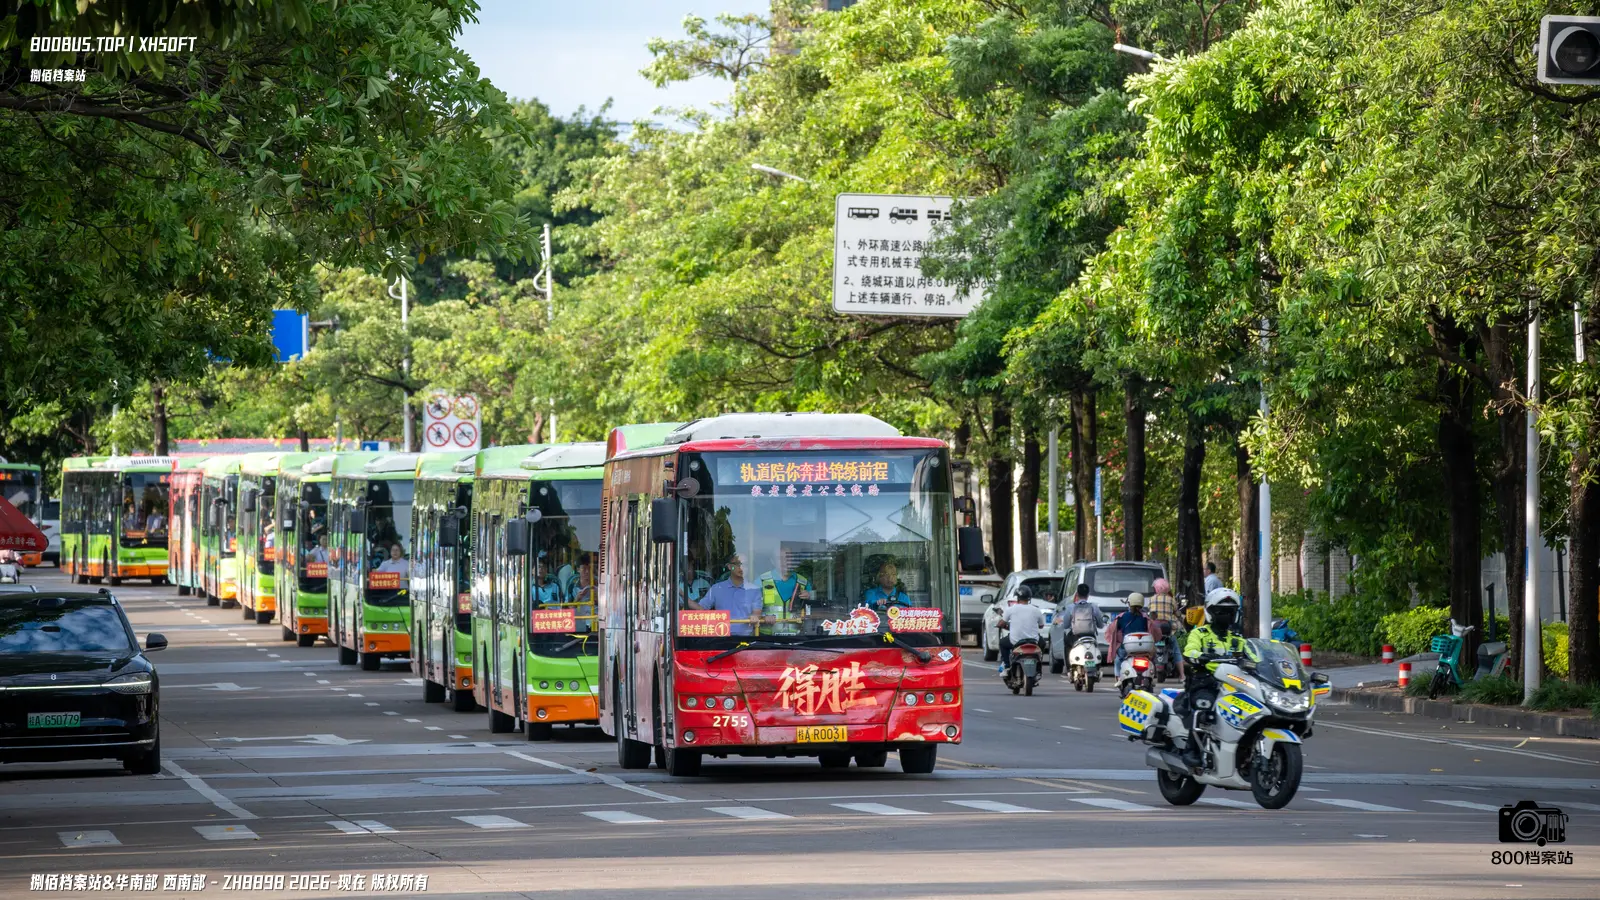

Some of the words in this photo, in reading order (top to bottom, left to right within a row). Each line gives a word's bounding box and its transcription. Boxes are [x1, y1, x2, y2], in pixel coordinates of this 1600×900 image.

[846, 291, 951, 306] 上述车辆通行、停泊。
[740, 461, 888, 482] 轨道陪你奔赴锦绣前程
[773, 661, 878, 718] 得胜
[1231, 696, 1253, 712] POLICE
[712, 715, 748, 727] 2755
